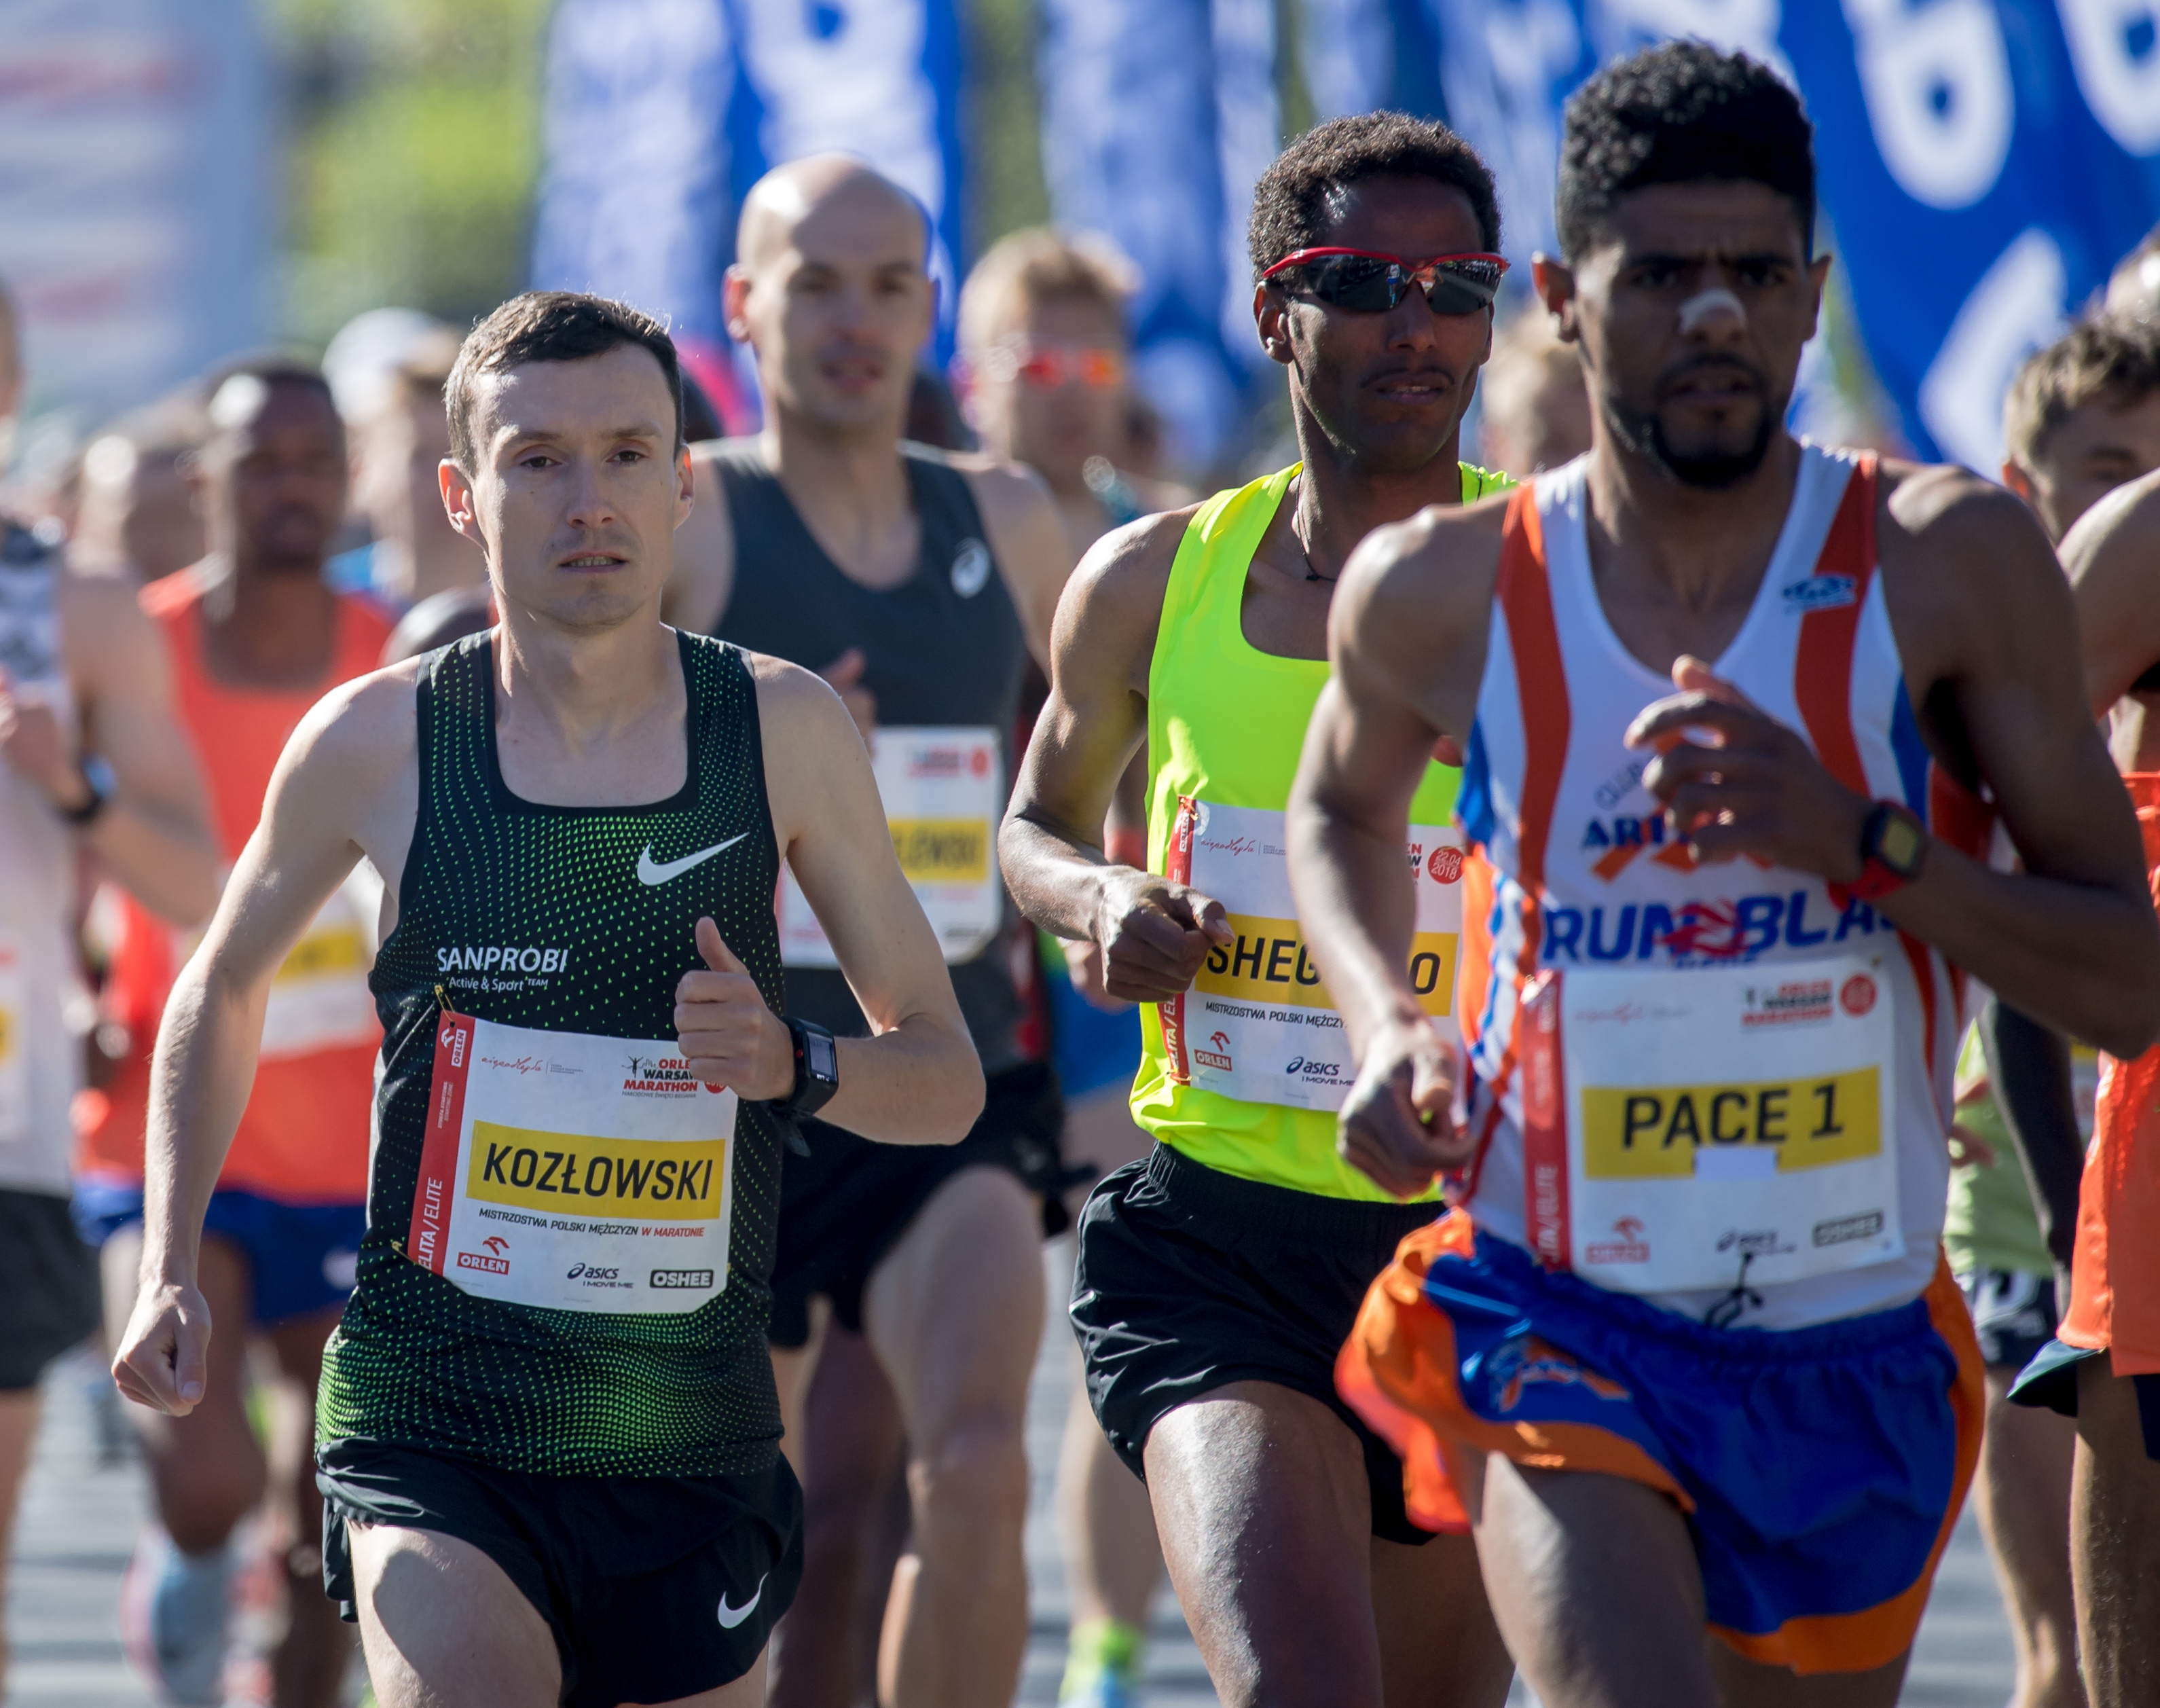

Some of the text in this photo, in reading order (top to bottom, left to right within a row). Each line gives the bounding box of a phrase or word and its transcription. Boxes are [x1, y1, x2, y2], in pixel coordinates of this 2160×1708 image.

[1435, 850, 1461, 867] 22.04
[1431, 862, 1458, 880] 2018
[437, 947, 568, 973] SANPROBI
[1207, 935, 1441, 995] SHEGO
[449, 977, 479, 989] Active
[481, 979, 489, 989] &
[492, 979, 524, 993] Sport
[1205, 1000, 1347, 1028] MISTRZOSTWA POLSKI MĘŻCZY
[454, 1032, 464, 1064] ORLEN
[659, 1058, 690, 1070] ORLE
[1197, 1052, 1230, 1069] ORLEN
[623, 1078, 698, 1092] MARATHON
[1306, 1076, 1338, 1086] MOVE
[1624, 1080, 1844, 1149] PACE 1
[483, 1142, 713, 1201] KOZŁOWSKI
[424, 1177, 442, 1220] ELITE
[479, 1207, 705, 1237] MISTRZOSTWA POLSKI MĘŻCZYZN W MARATONIE
[460, 1254, 507, 1273] ORLEN
[584, 1267, 619, 1279] asics
[653, 1271, 711, 1287] OSHEE
